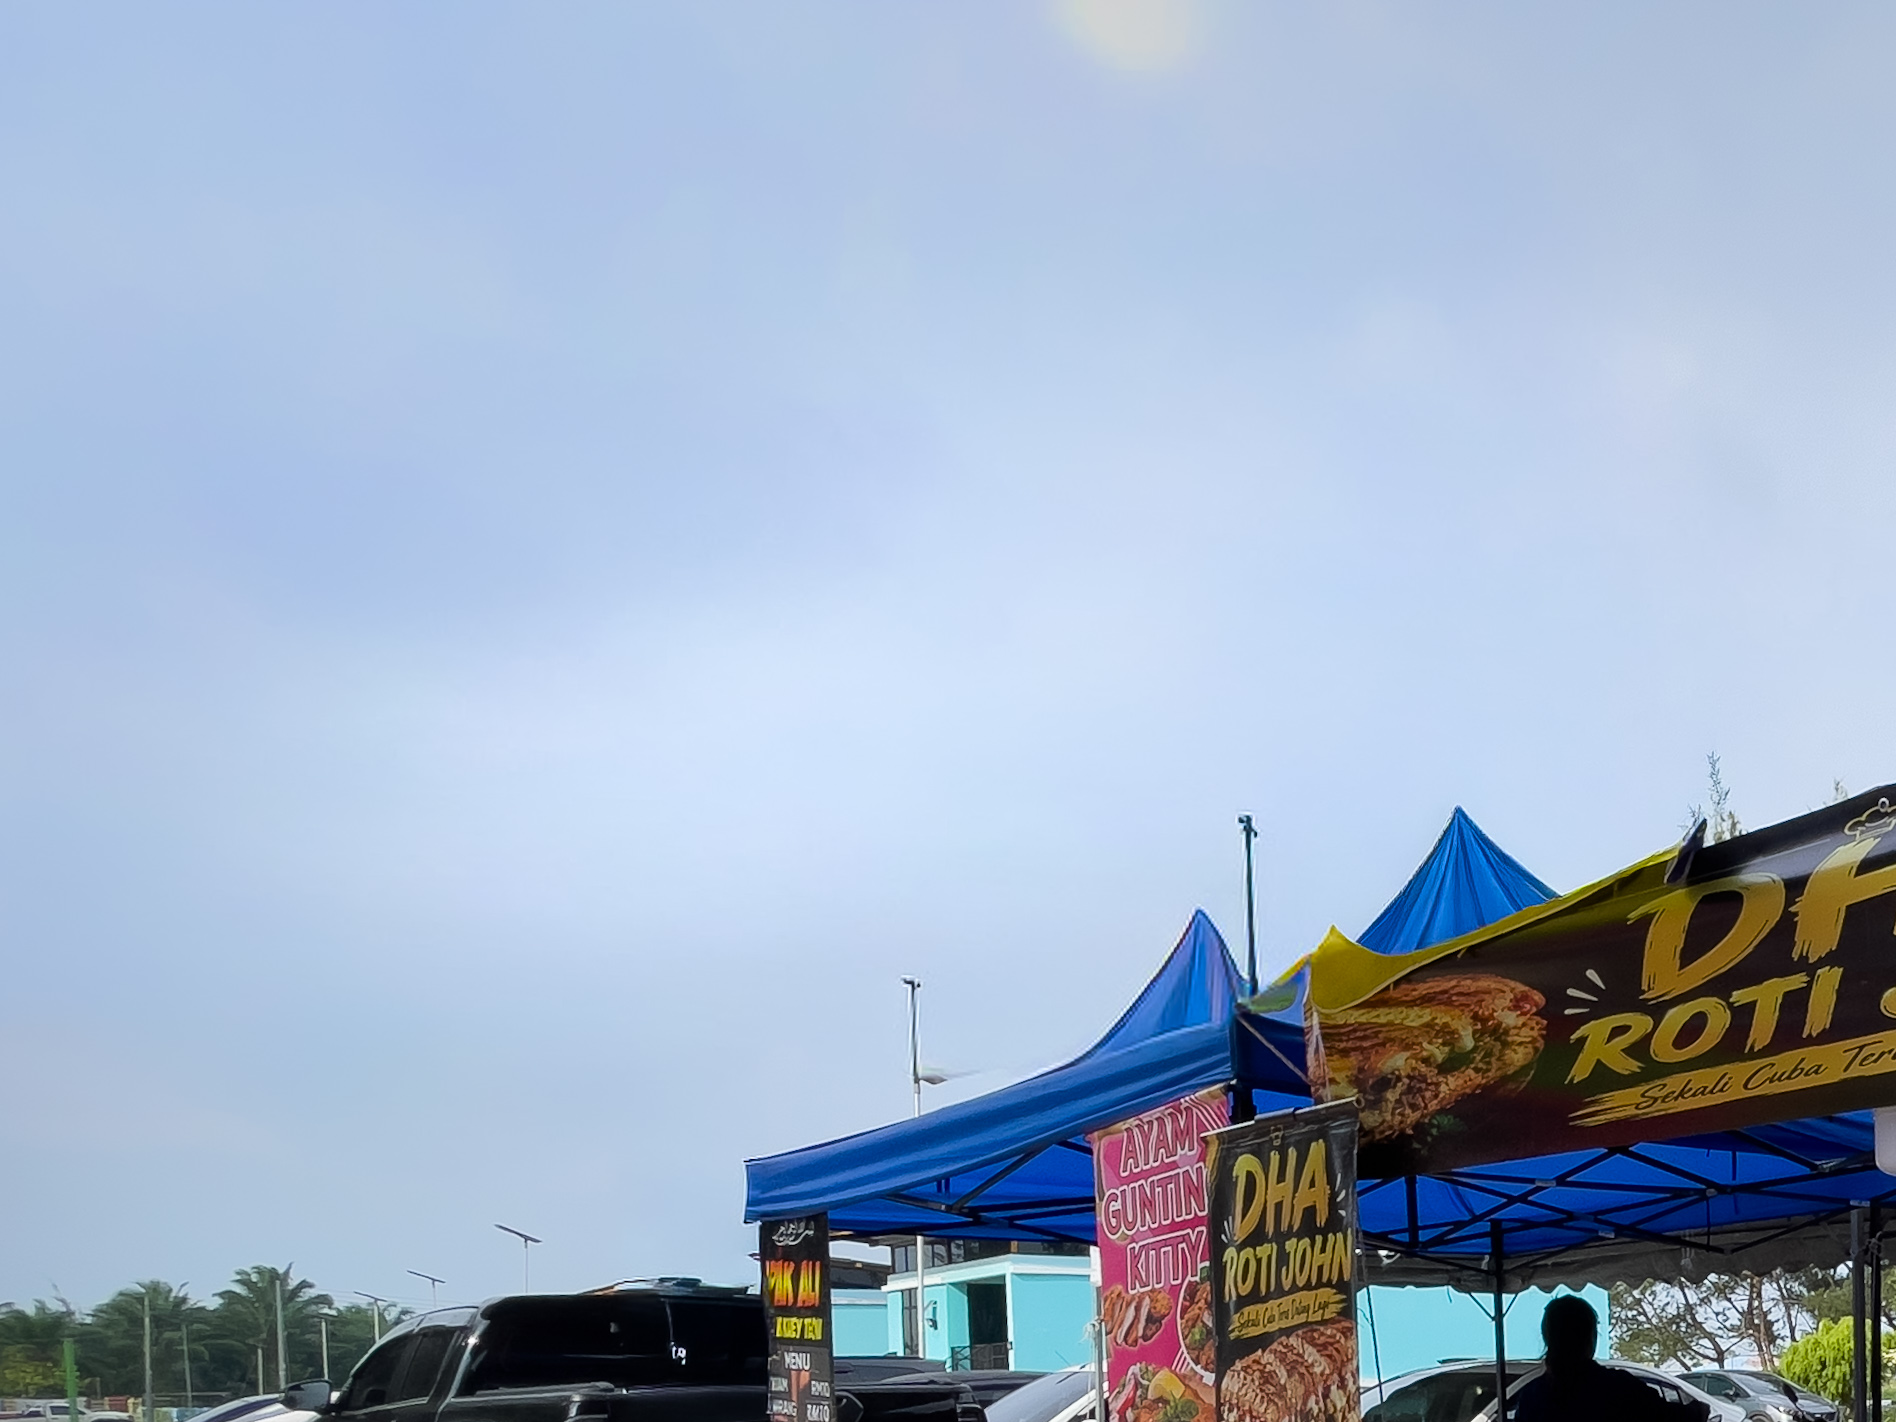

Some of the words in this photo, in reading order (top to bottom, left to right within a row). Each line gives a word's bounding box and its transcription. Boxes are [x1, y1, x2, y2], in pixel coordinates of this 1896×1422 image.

[1567, 967, 1842, 1083] ROTI
[1634, 1074, 1733, 1112] Sekali
[1742, 1051, 1829, 1096] Cuba
[1120, 1104, 1198, 1177] AYAM
[1233, 1139, 1330, 1243] DHA
[1126, 1227, 1208, 1294] KITTY
[1223, 1242, 1277, 1302] ROTI
[1281, 1228, 1352, 1288] JOHN
[784, 1352, 811, 1370] MENU
